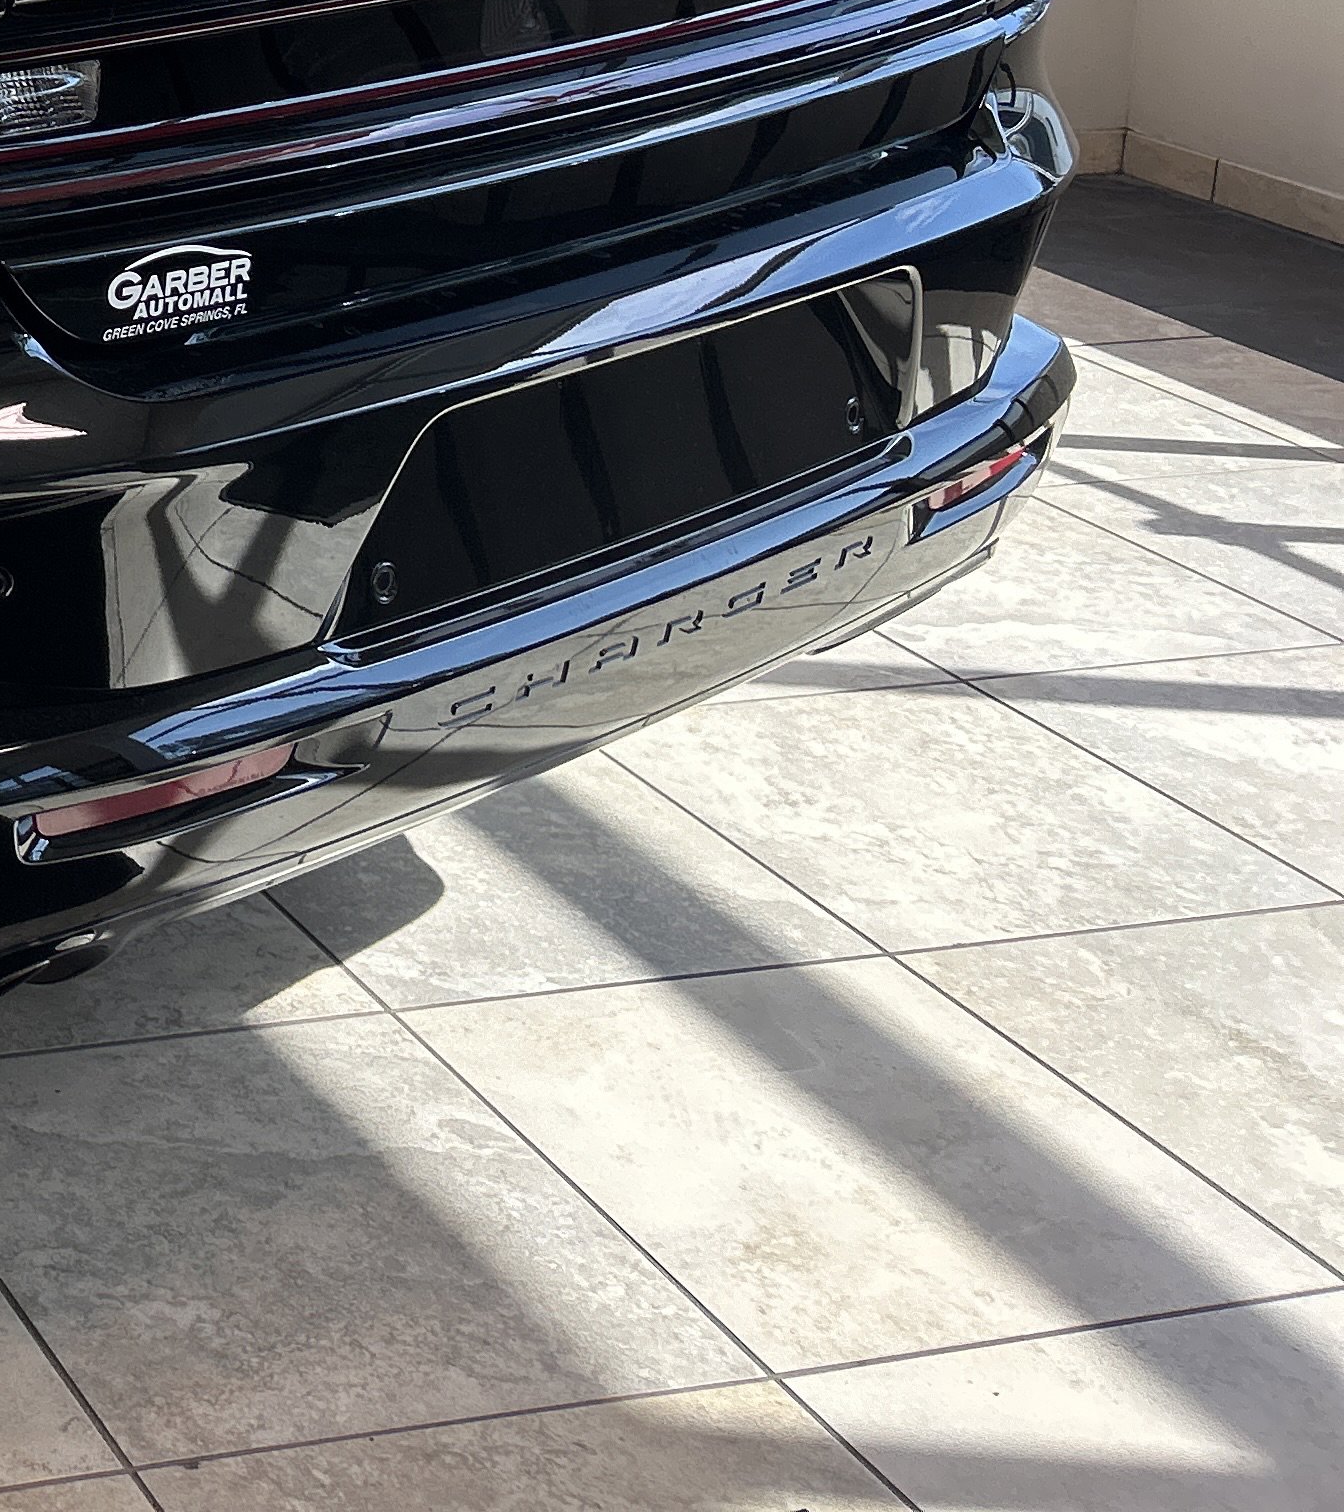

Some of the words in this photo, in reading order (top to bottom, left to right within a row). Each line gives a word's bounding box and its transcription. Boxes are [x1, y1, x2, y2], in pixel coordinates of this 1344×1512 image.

[108, 258, 252, 309] GARBER
[133, 283, 248, 320] AUTOMALL
[103, 323, 145, 342] GREEN
[146, 314, 180, 334] COVE
[180, 306, 233, 328] SPRINGS,
[234, 303, 248, 316] FL
[438, 535, 873, 728] CHARGER
